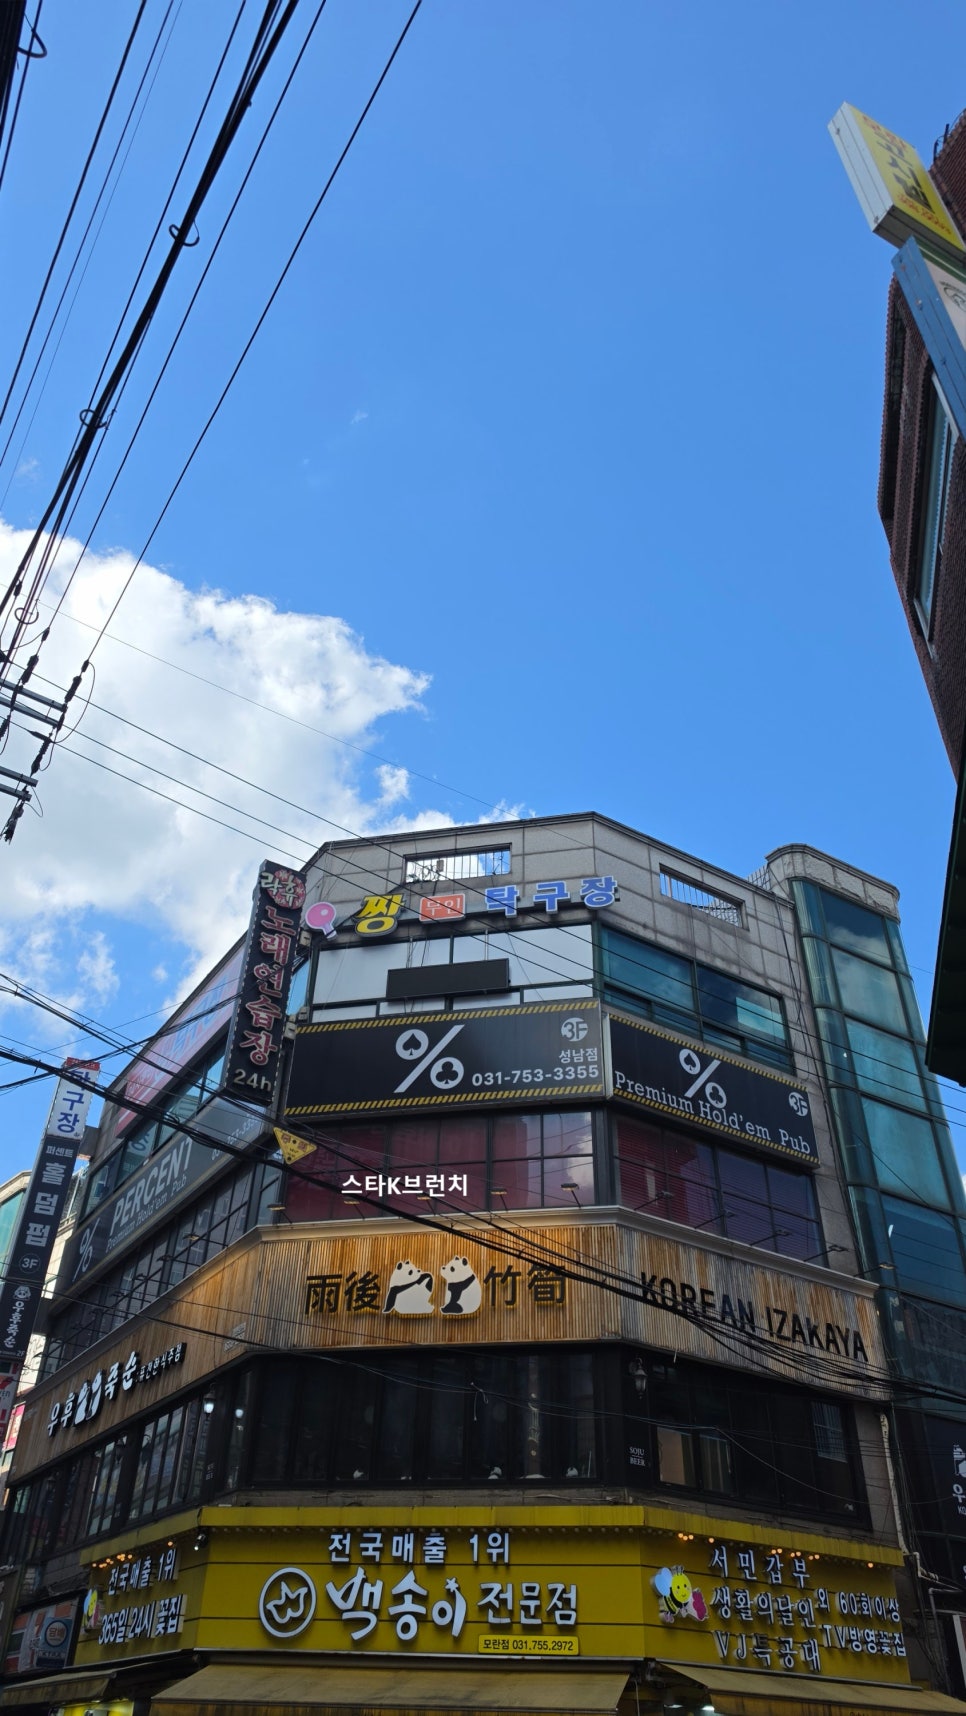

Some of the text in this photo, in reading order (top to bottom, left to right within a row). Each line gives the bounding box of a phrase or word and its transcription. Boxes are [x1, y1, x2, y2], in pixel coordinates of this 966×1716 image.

[355, 893, 405, 935] 짱
[484, 875, 619, 919] 탁구장
[239, 905, 296, 1066] 노래연습장
[562, 1020, 589, 1041] 3F
[471, 1064, 600, 1087] 031-753-3355
[558, 1047, 599, 1064] 성남점
[233, 1067, 272, 1092] 24h
[614, 1070, 812, 1155] Premium Hold'em Pub
[46, 1145, 74, 1159] 퍼센트
[25, 1161, 67, 1247] 홀덤펍
[109, 1135, 194, 1237] PERCENT
[22, 1257, 39, 1269] 3F
[305, 1270, 382, 1315] 雨後
[3, 1300, 25, 1349] 우후죽순
[640, 1271, 869, 1363] KOREAN IZAKAYA
[47, 1392, 76, 1437] 우후
[104, 1350, 139, 1399] 죽순
[328, 1532, 510, 1564] 전국매출 1위
[711, 1545, 811, 1589] 서민갑부
[108, 1548, 177, 1596] 전국매출 1위
[98, 1593, 183, 1645] 365일 24시 꽃집
[325, 1566, 577, 1641] 백송이 전문점
[815, 1587, 830, 1613] 외
[482, 1638, 574, 1652] 모란점 031.755.2972
[713, 1630, 822, 1673] VJ특공대
